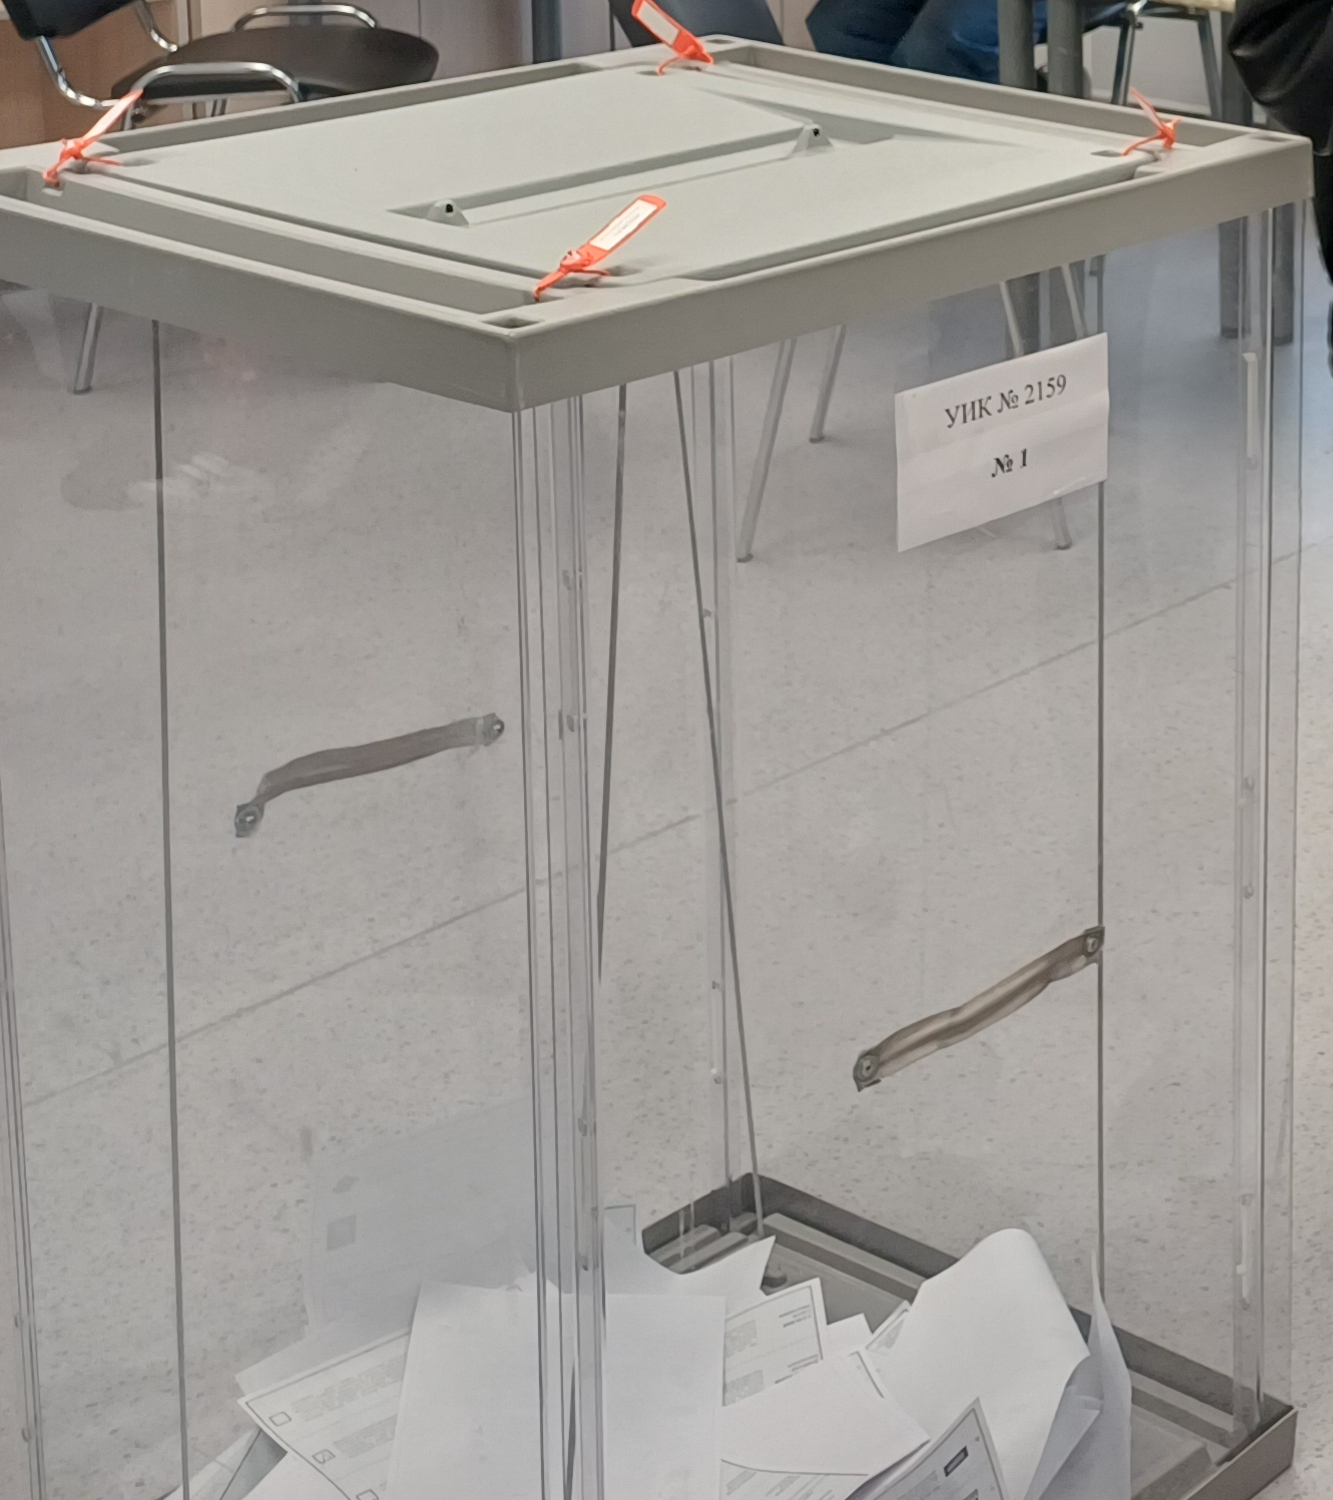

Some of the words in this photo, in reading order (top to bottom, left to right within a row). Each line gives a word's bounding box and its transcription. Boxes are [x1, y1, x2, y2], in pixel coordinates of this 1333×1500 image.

[944, 395, 993, 429] УИК
[996, 389, 1019, 414] №
[1024, 373, 1068, 405] 2159
[990, 453, 1014, 478] №
[1019, 448, 1029, 469] 1
